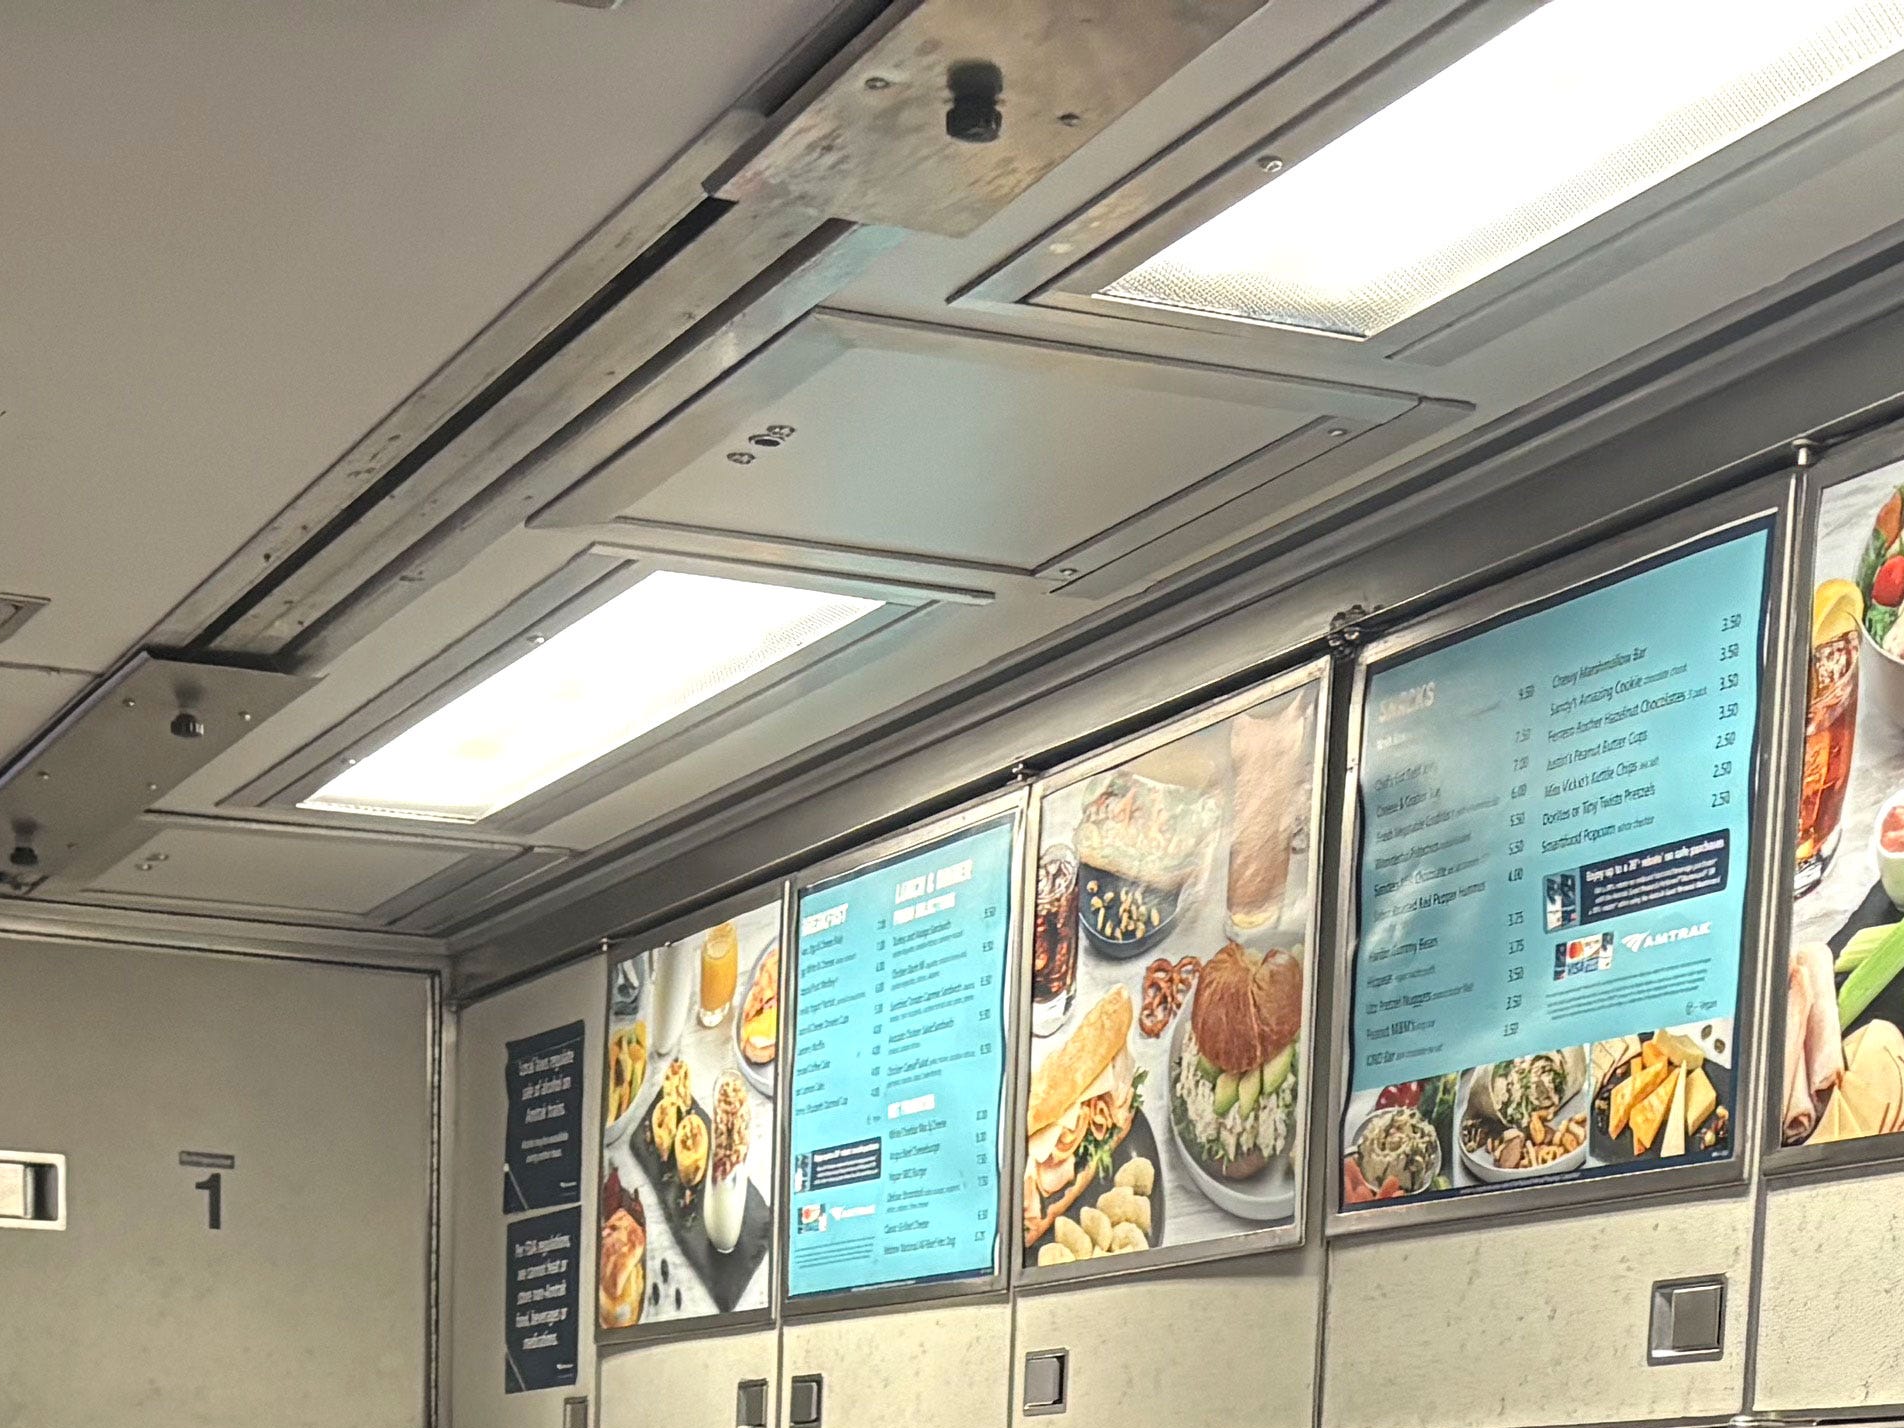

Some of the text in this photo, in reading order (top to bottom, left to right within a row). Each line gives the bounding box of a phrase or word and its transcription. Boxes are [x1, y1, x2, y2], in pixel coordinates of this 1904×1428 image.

[1719, 702, 1739, 720] 3.50
[1713, 761, 1732, 779] 2.50
[1643, 922, 1711, 948] AMTRAK
[195, 1171, 222, 1230] 1
